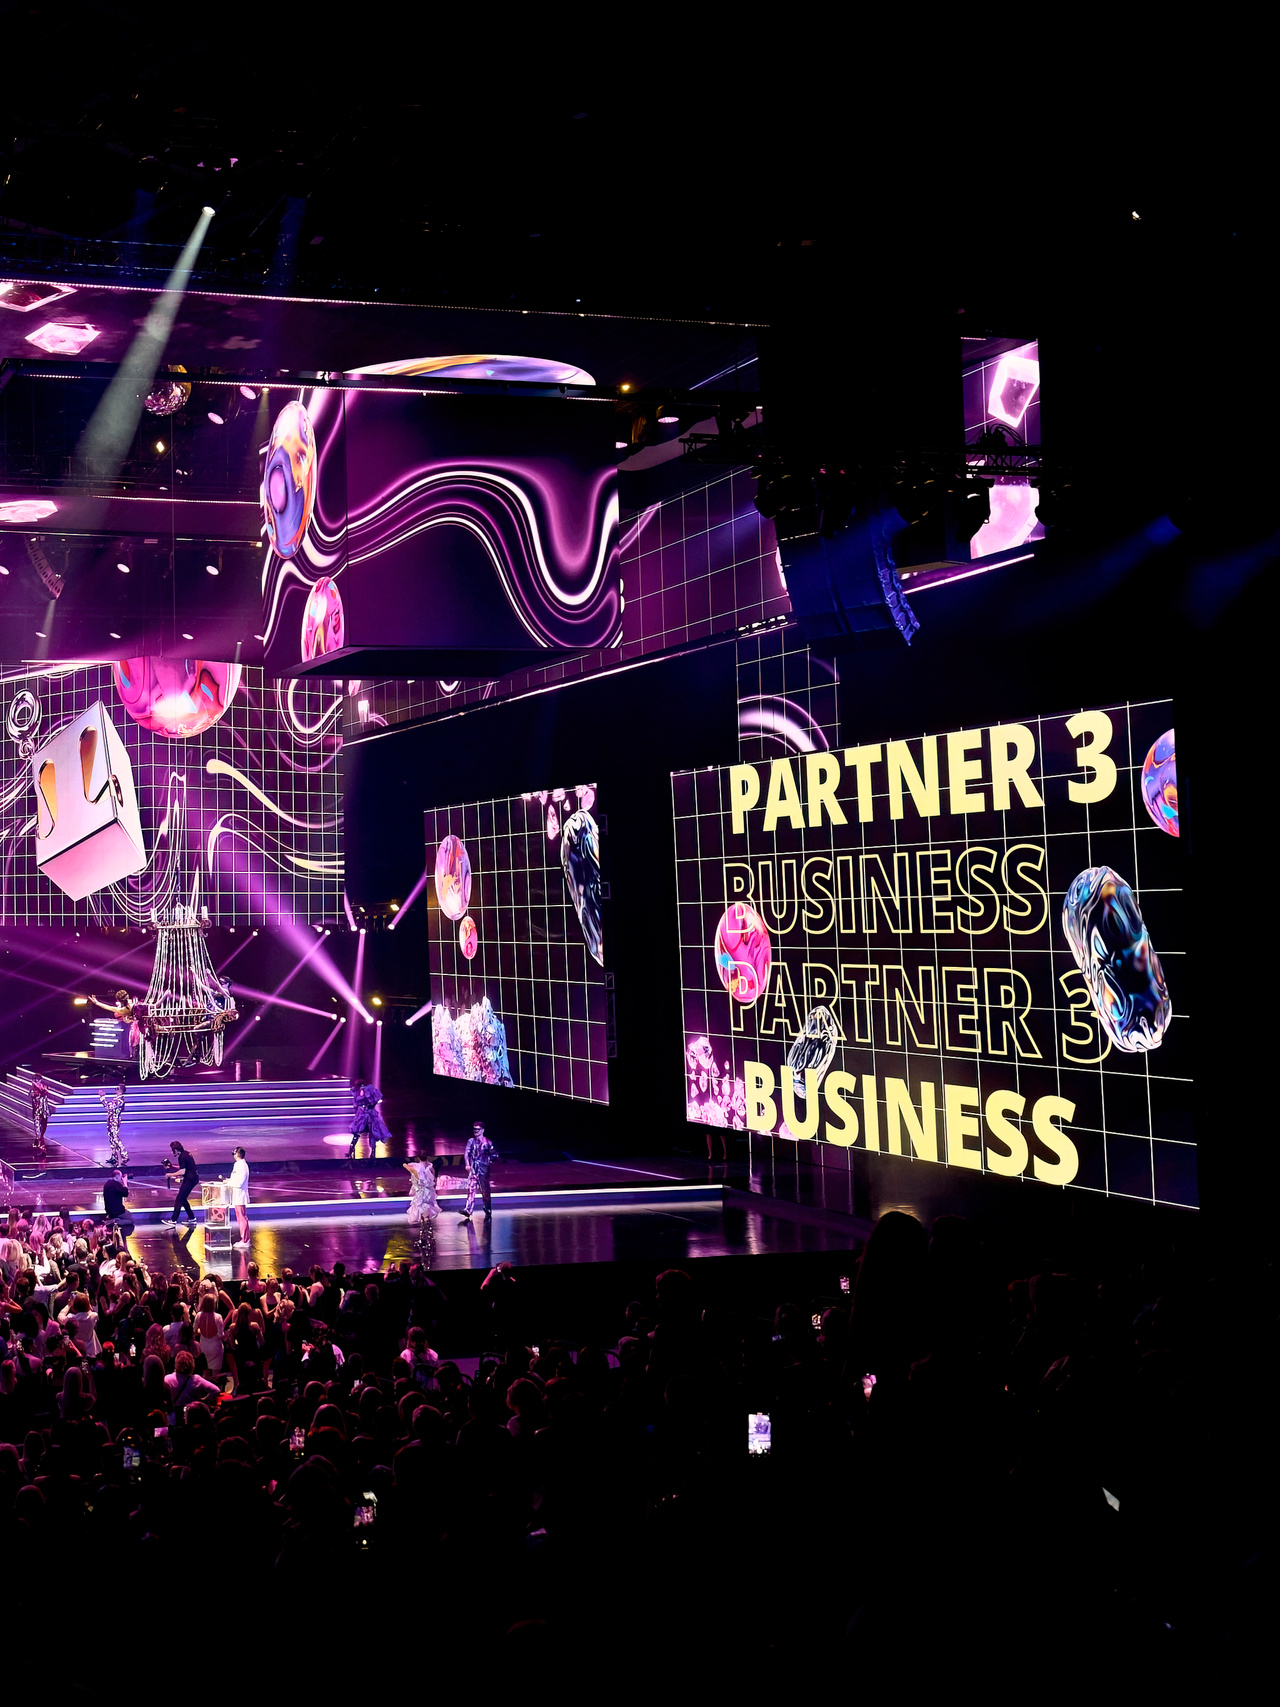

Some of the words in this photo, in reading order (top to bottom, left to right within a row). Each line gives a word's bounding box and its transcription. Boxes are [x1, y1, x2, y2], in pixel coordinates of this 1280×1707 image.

[729, 723, 1045, 835] PARTNER
[1065, 710, 1117, 803] 3
[723, 843, 1049, 934] BUSINESS
[727, 961, 1043, 1059] PARTNER
[1058, 968, 1113, 1064] 3
[743, 1060, 1080, 1186] BUSINESS
